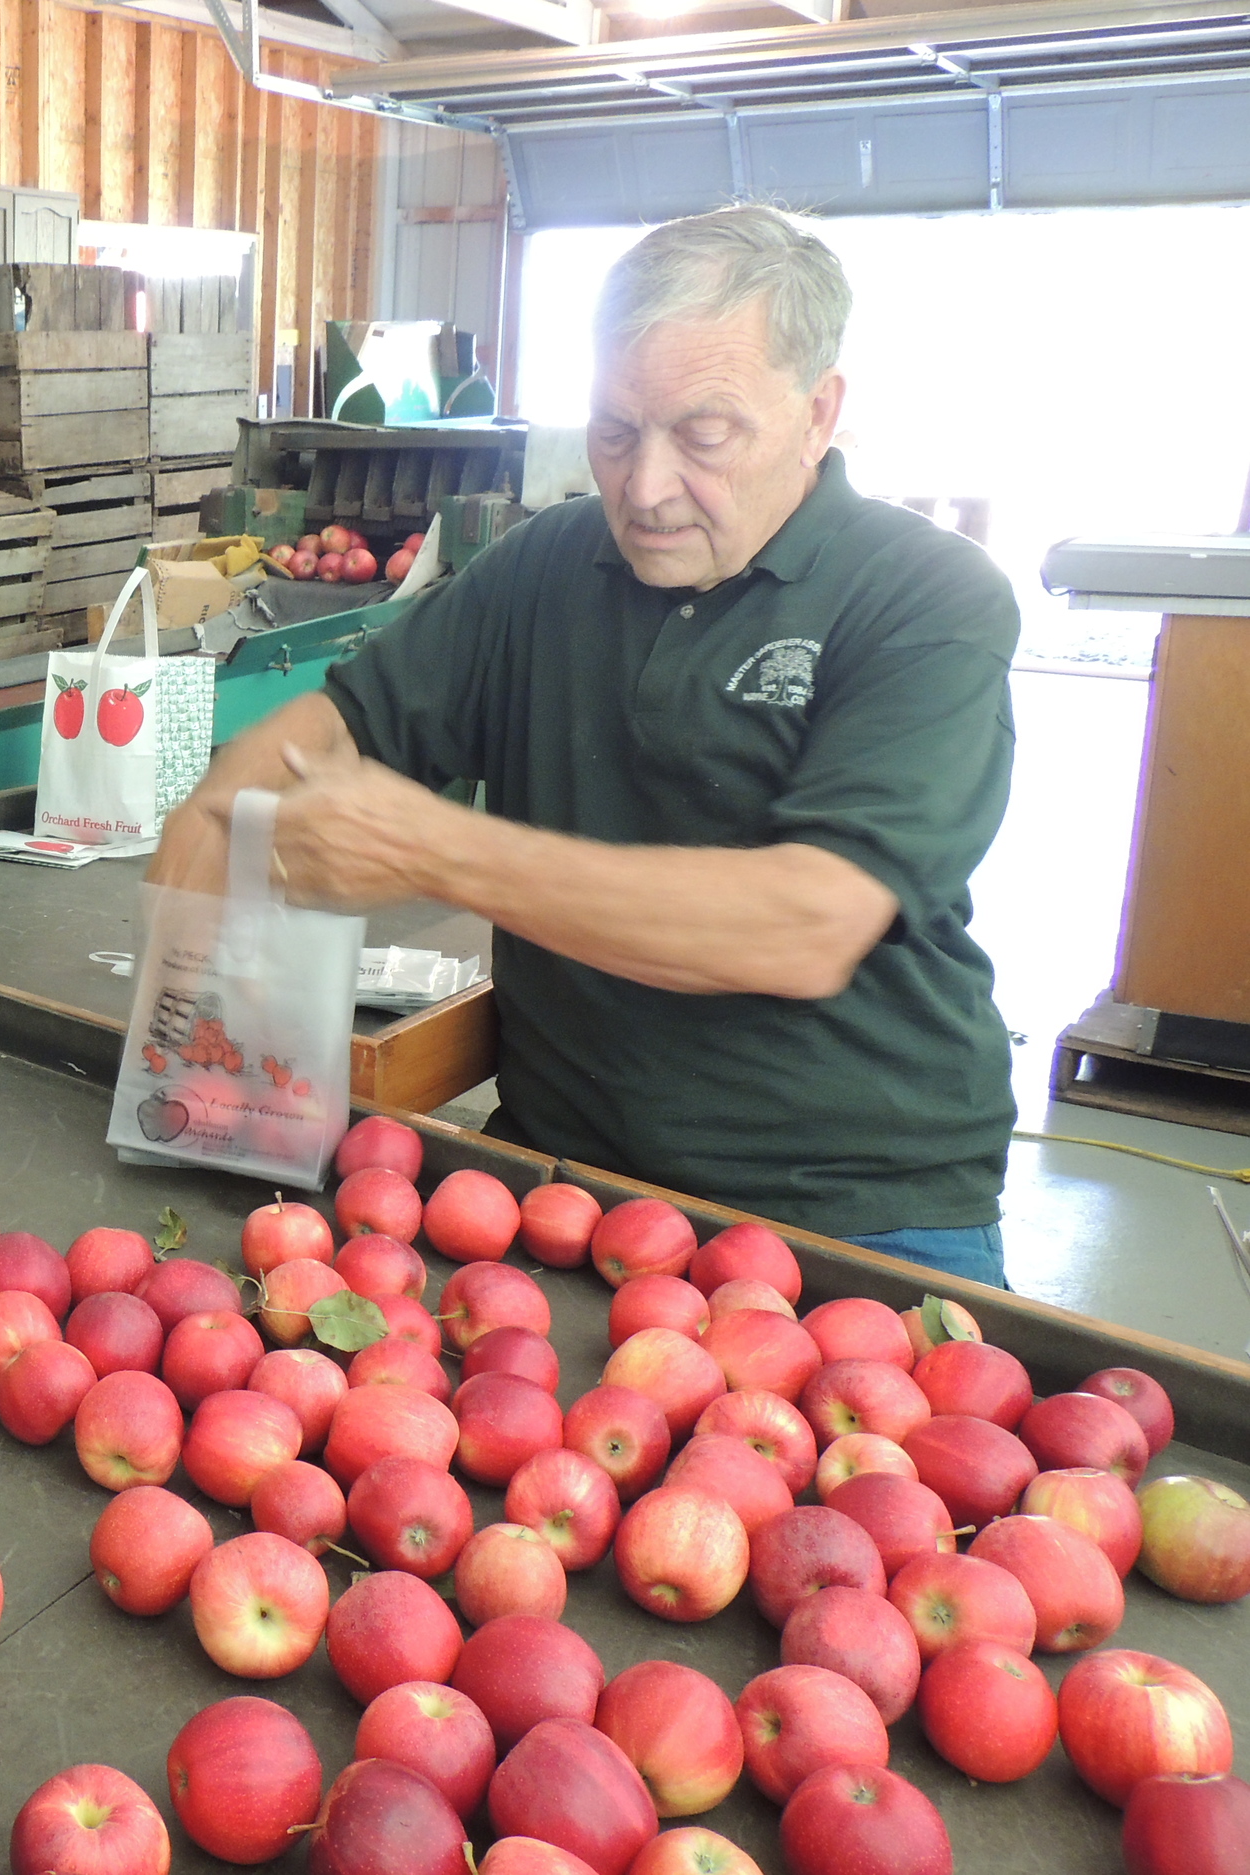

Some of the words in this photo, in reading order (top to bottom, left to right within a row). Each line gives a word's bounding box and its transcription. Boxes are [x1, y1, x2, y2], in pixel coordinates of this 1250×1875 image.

[726, 656, 756, 692] MASTER
[41, 811, 81, 828] Orchard
[82, 817, 113, 832] Fresh
[114, 820, 143, 834] Fruit
[210, 1098, 255, 1114] Locally
[258, 1105, 304, 1121] Grown
